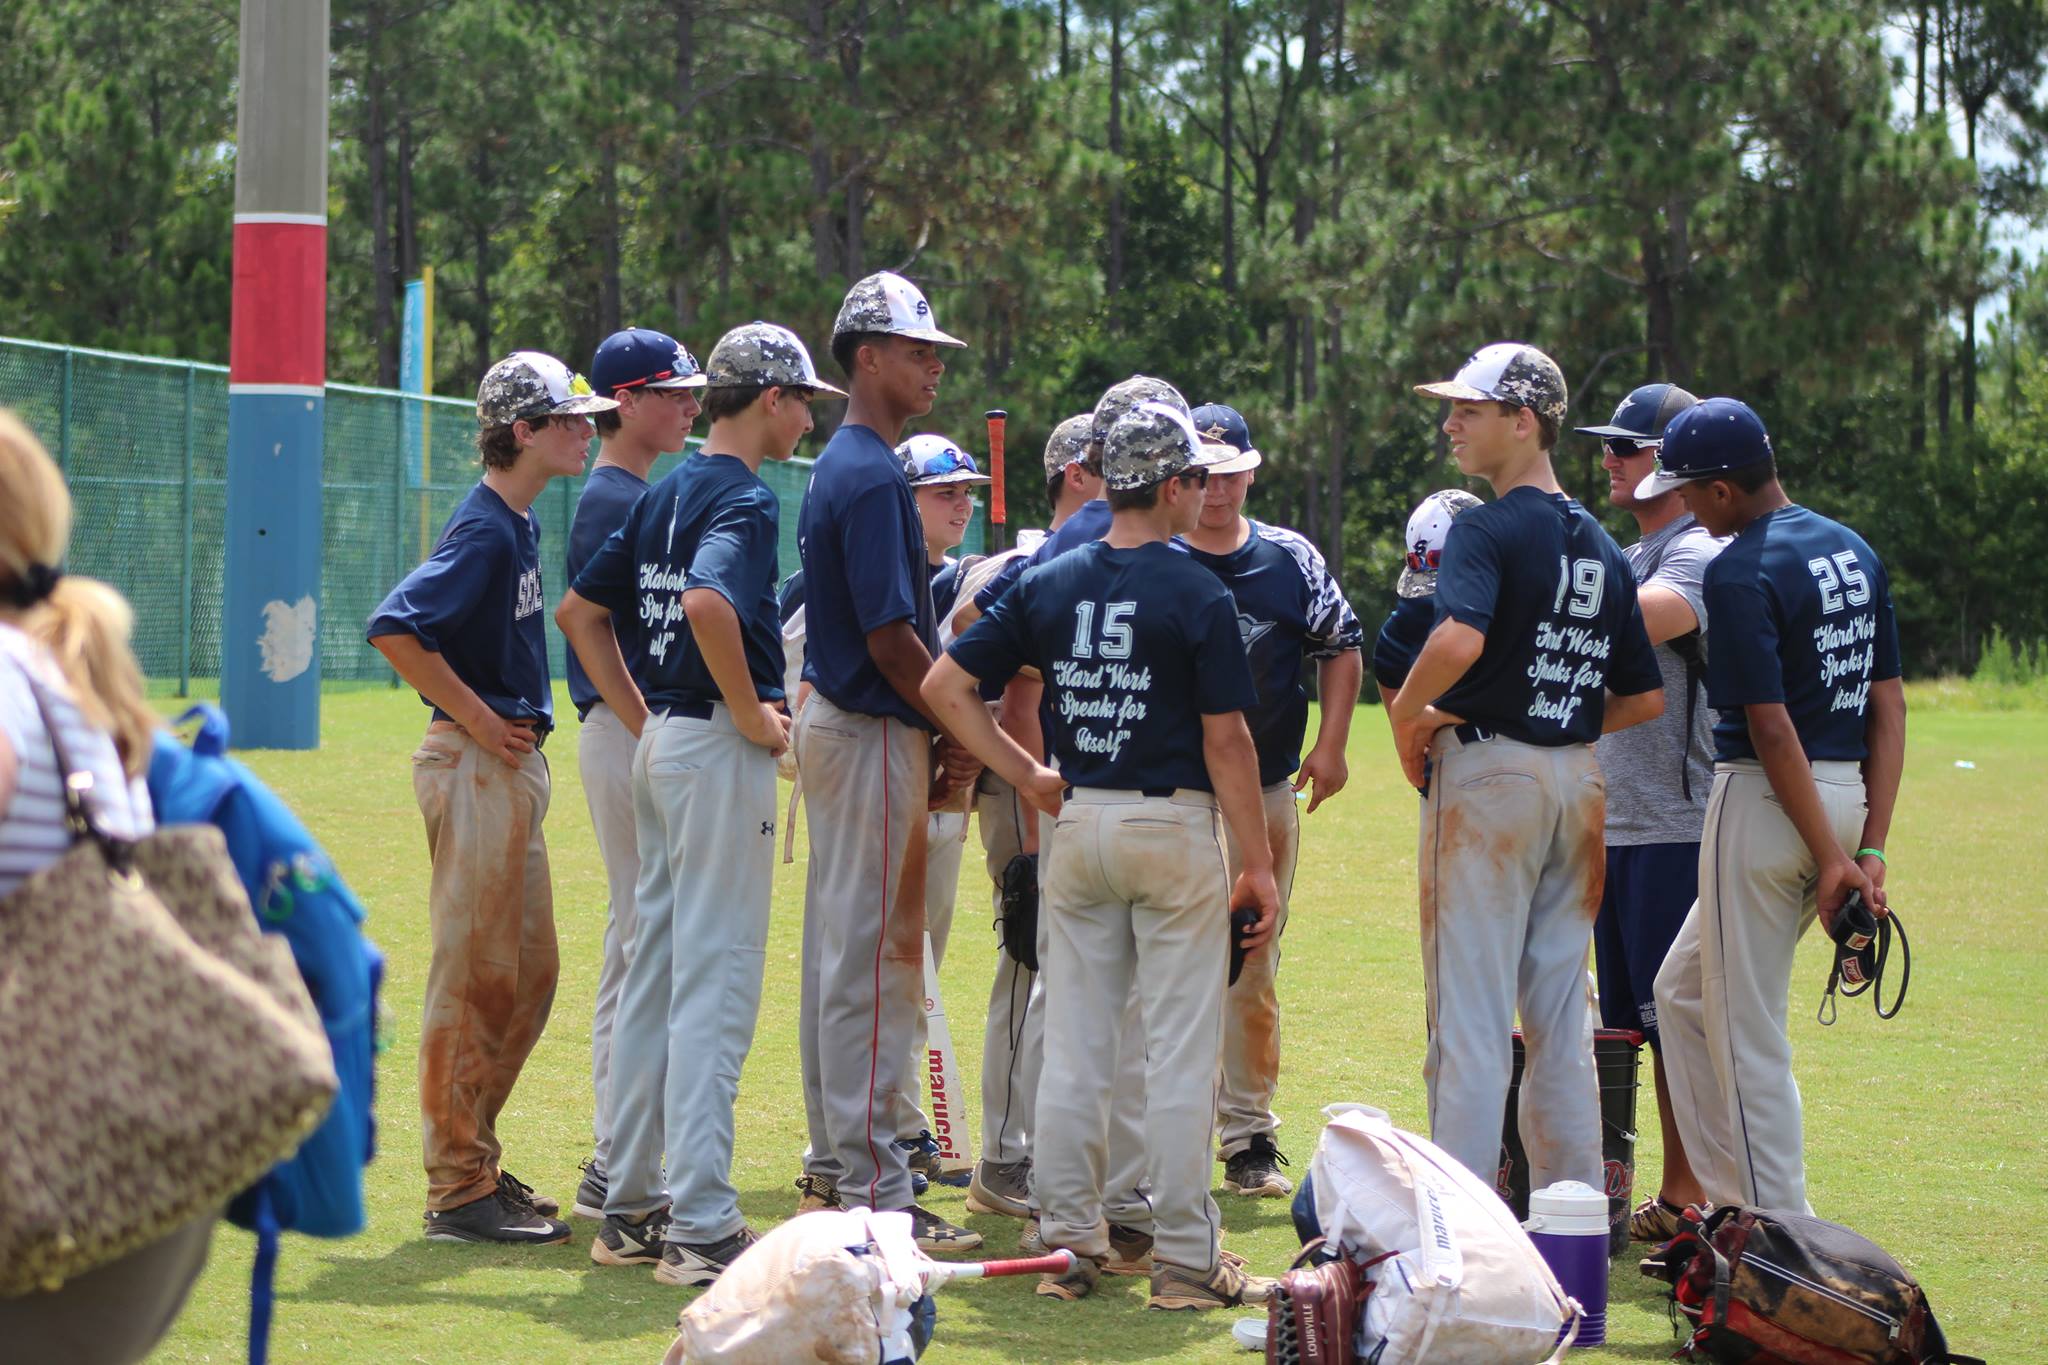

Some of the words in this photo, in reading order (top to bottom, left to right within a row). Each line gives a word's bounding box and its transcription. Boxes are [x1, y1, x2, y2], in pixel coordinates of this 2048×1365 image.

[1553, 554, 1606, 619] 19
[1808, 550, 1871, 615] 25
[1072, 600, 1137, 660] 15
[1566, 626, 1611, 660] Work
[1053, 660, 1104, 689] "Hard
[1105, 663, 1151, 691] Work
[1570, 661, 1604, 693] for
[1060, 690, 1117, 724] Speaks
[1117, 695, 1147, 728] for
[1075, 727, 1131, 762] Itself"
[928, 1049, 961, 1160] marucci
[1302, 1303, 1318, 1357] LOUISVILLE
